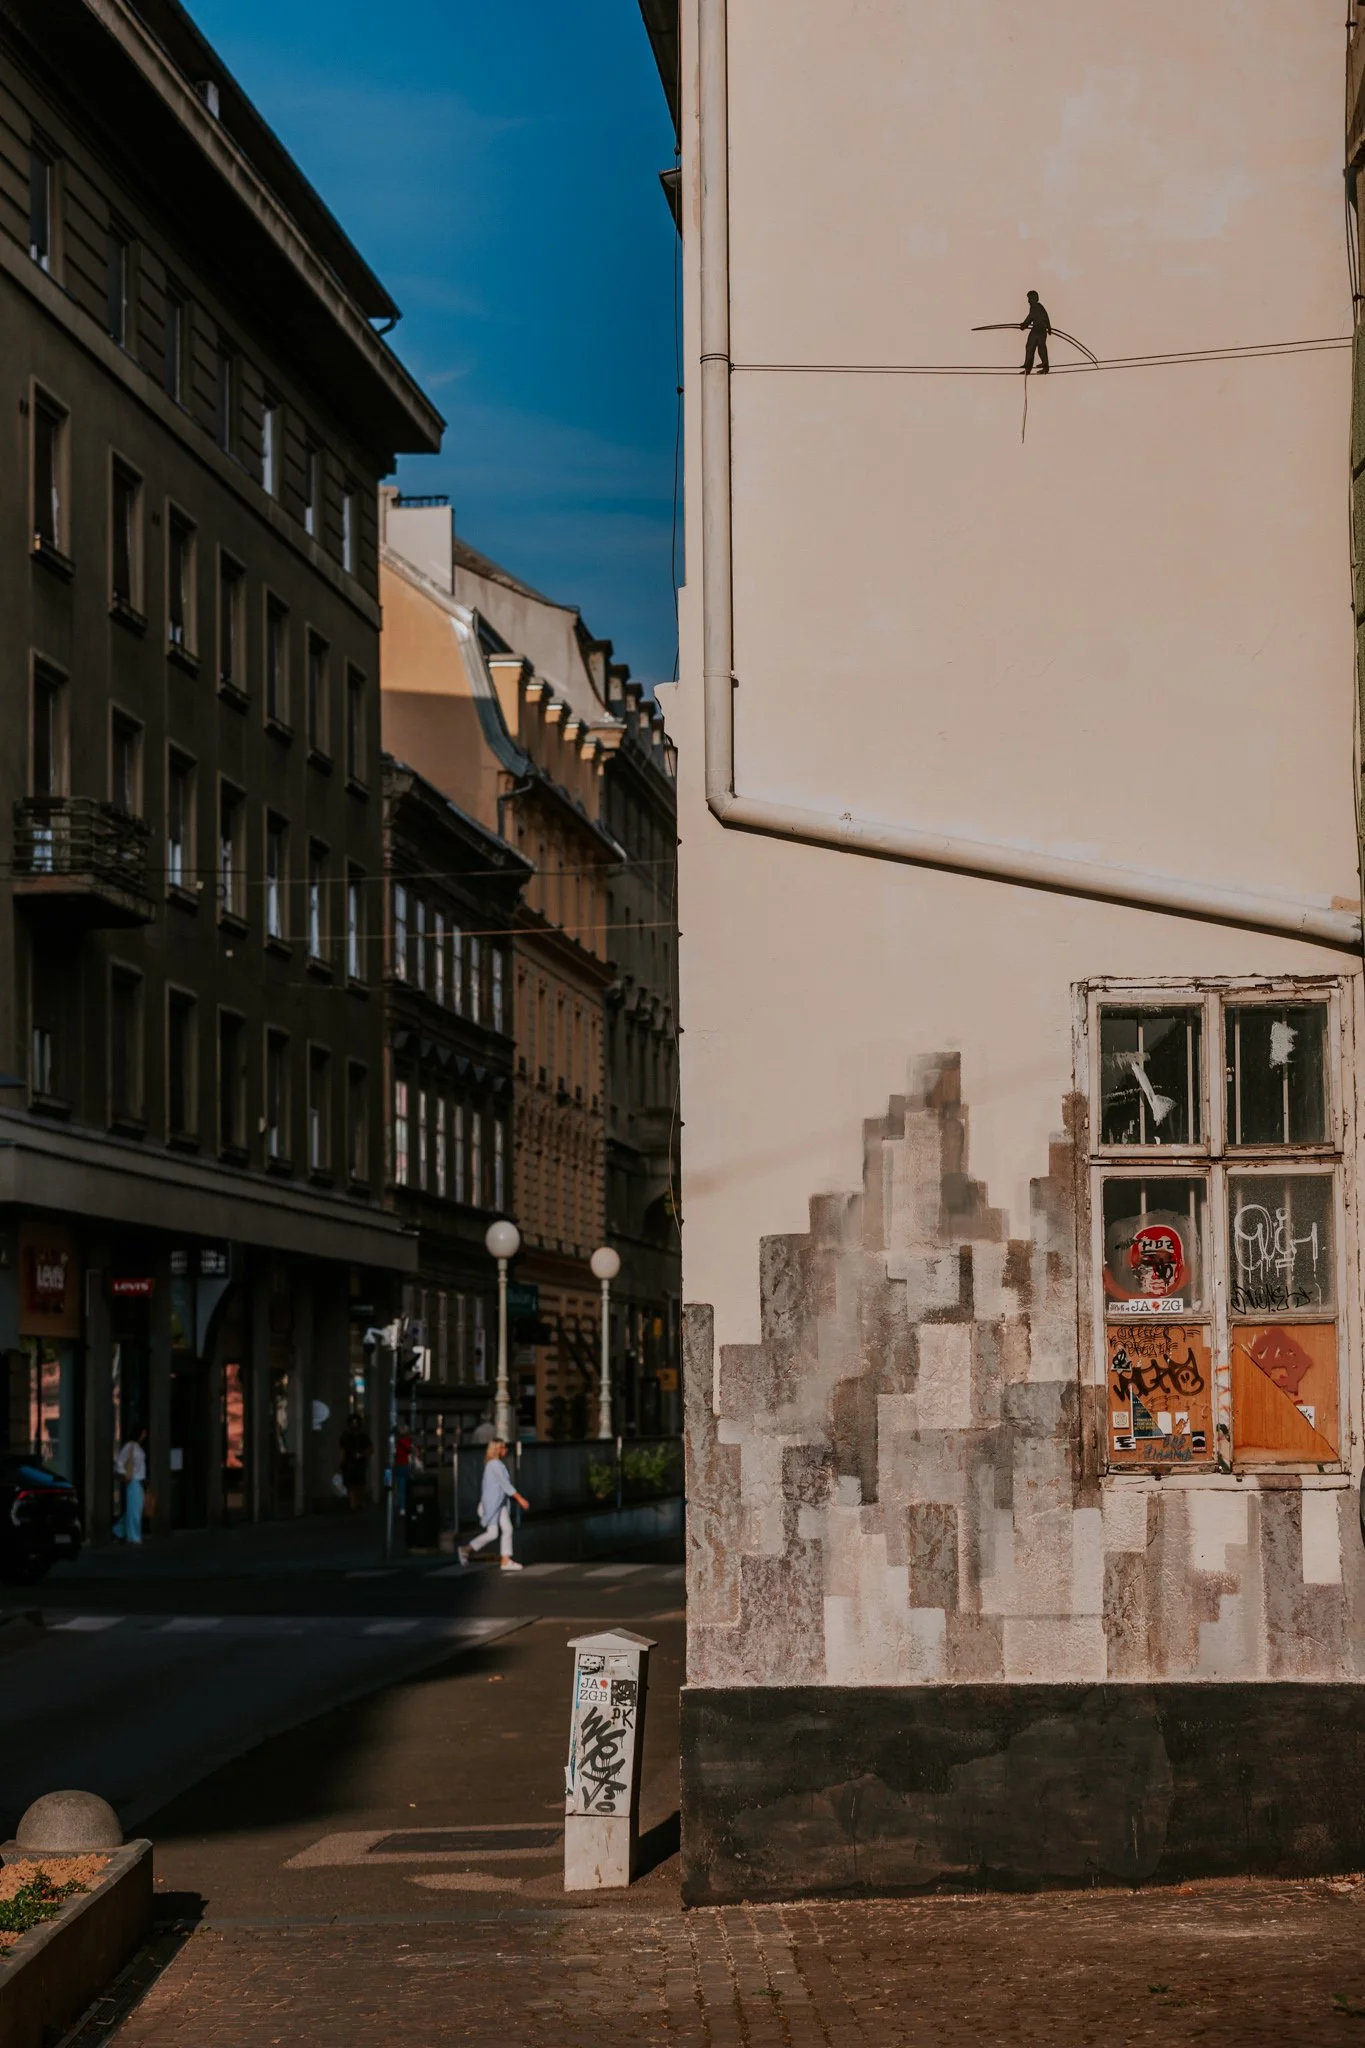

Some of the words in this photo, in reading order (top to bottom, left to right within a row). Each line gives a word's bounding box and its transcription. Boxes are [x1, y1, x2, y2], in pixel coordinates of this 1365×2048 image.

[1130, 1300, 1151, 1312] JA
[1161, 1300, 1182, 1311] ZG
[580, 1678, 599, 1690] JA
[579, 1690, 608, 1702] ZGB
